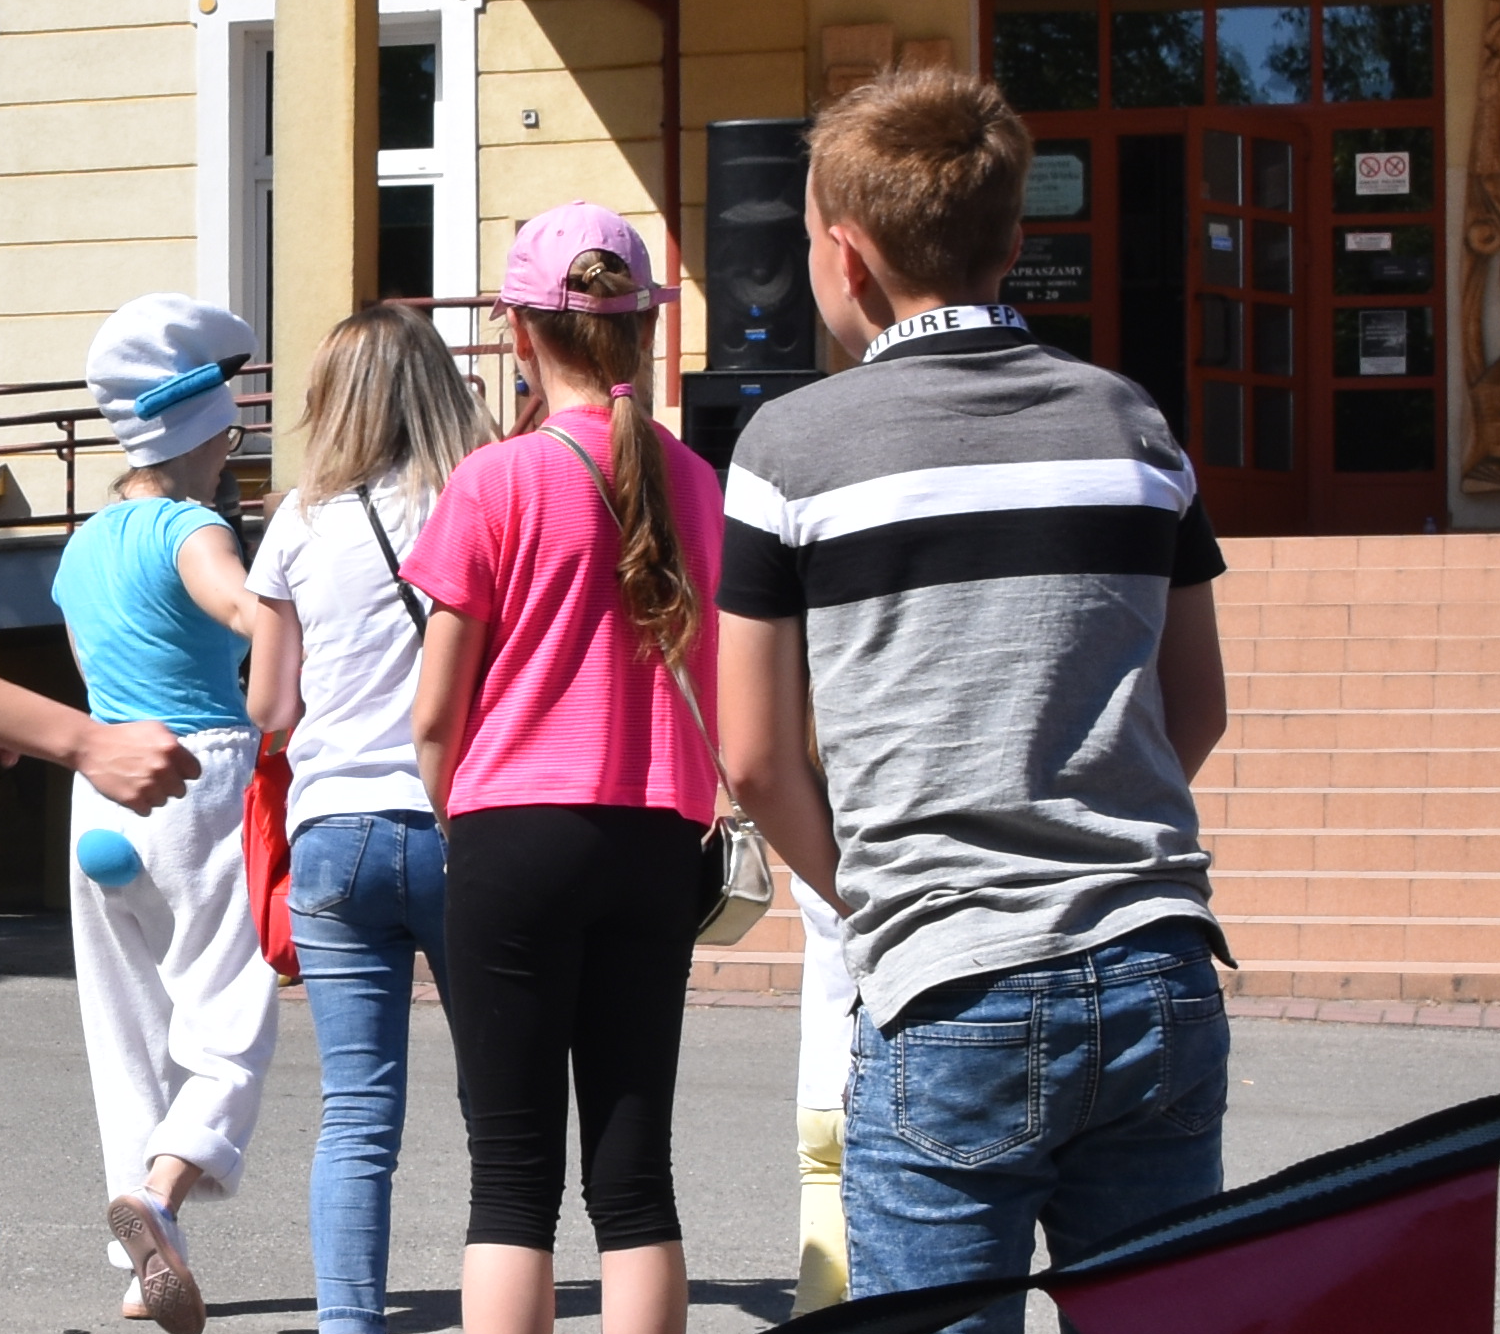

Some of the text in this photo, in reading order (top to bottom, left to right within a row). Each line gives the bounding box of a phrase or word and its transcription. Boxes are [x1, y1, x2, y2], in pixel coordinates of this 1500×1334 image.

[1010, 266, 1083, 276] APRASZAMY
[1045, 290, 1059, 300] 20
[867, 309, 960, 357] UTURE
